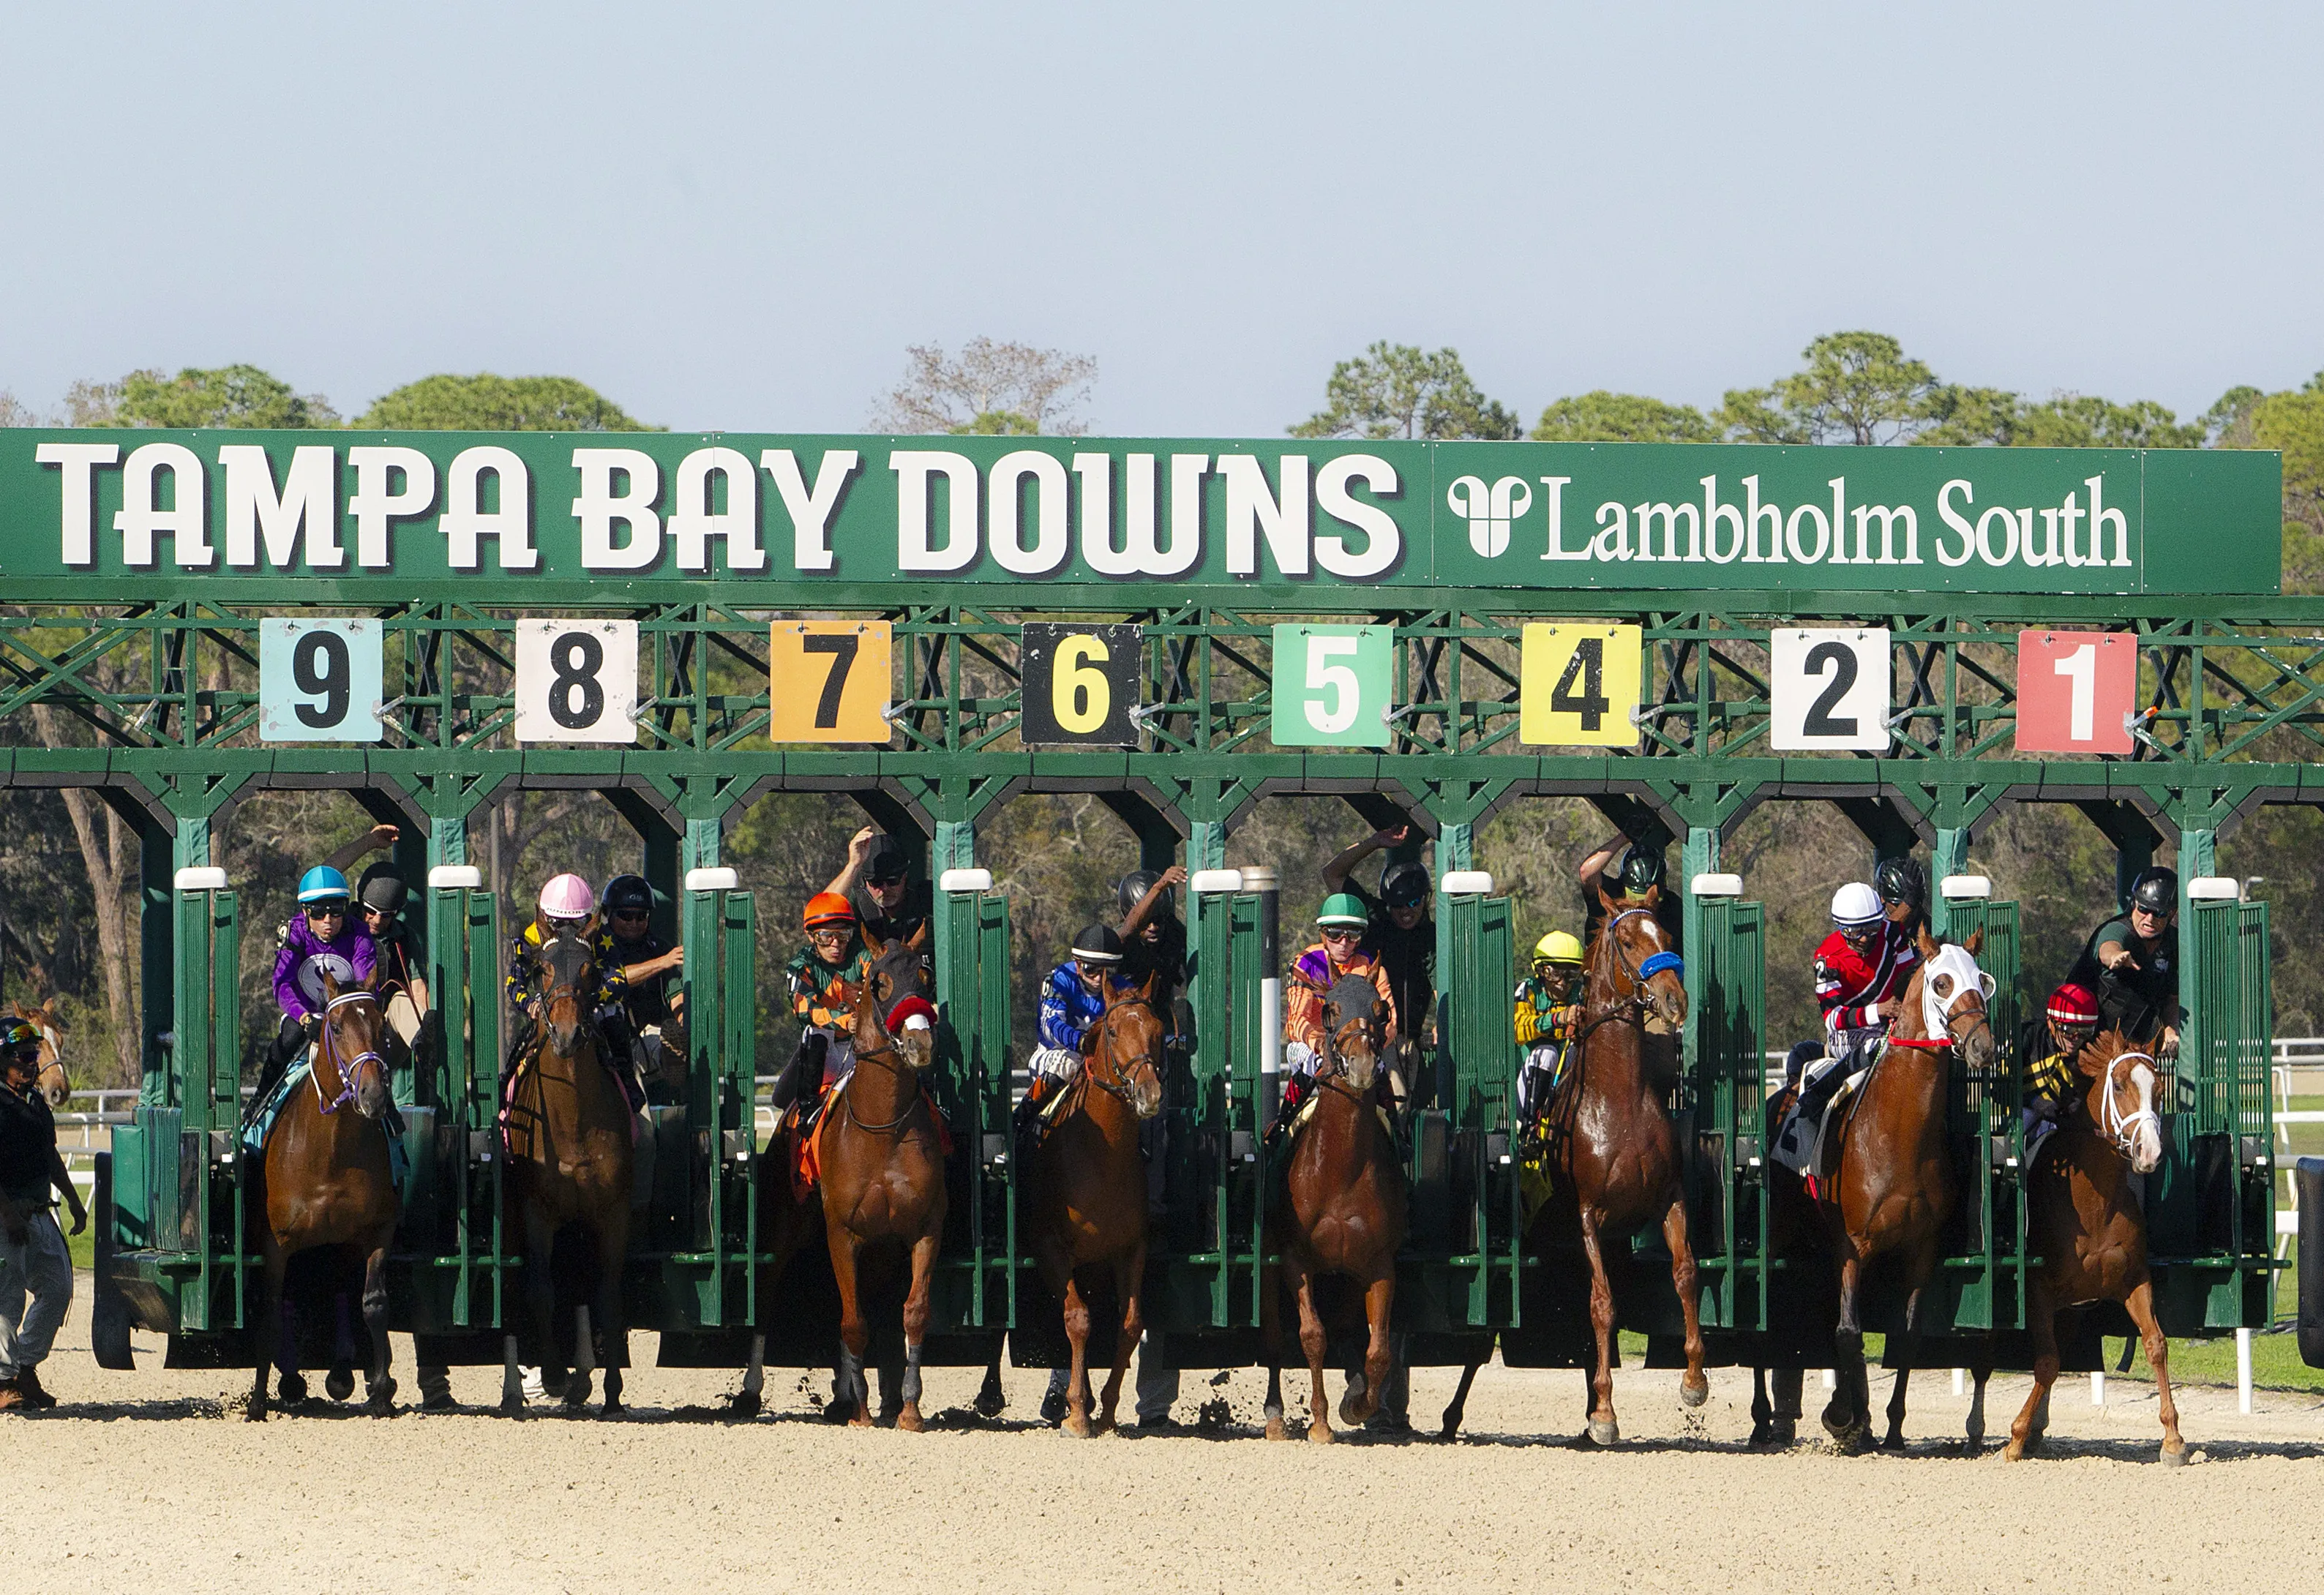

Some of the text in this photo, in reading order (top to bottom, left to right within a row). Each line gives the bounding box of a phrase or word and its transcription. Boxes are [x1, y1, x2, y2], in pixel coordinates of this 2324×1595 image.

[35, 443, 1400, 577] TAMPA BAY DOWNS
[1540, 474, 2132, 568] Lambholm South
[293, 630, 351, 729] 9
[549, 631, 604, 729] 8
[803, 634, 859, 729] 7
[1052, 634, 1110, 735] 6
[1302, 636, 1360, 735] 5
[1551, 638, 1609, 731] 4
[1803, 642, 1859, 736] 2
[2054, 644, 2096, 741] 1
